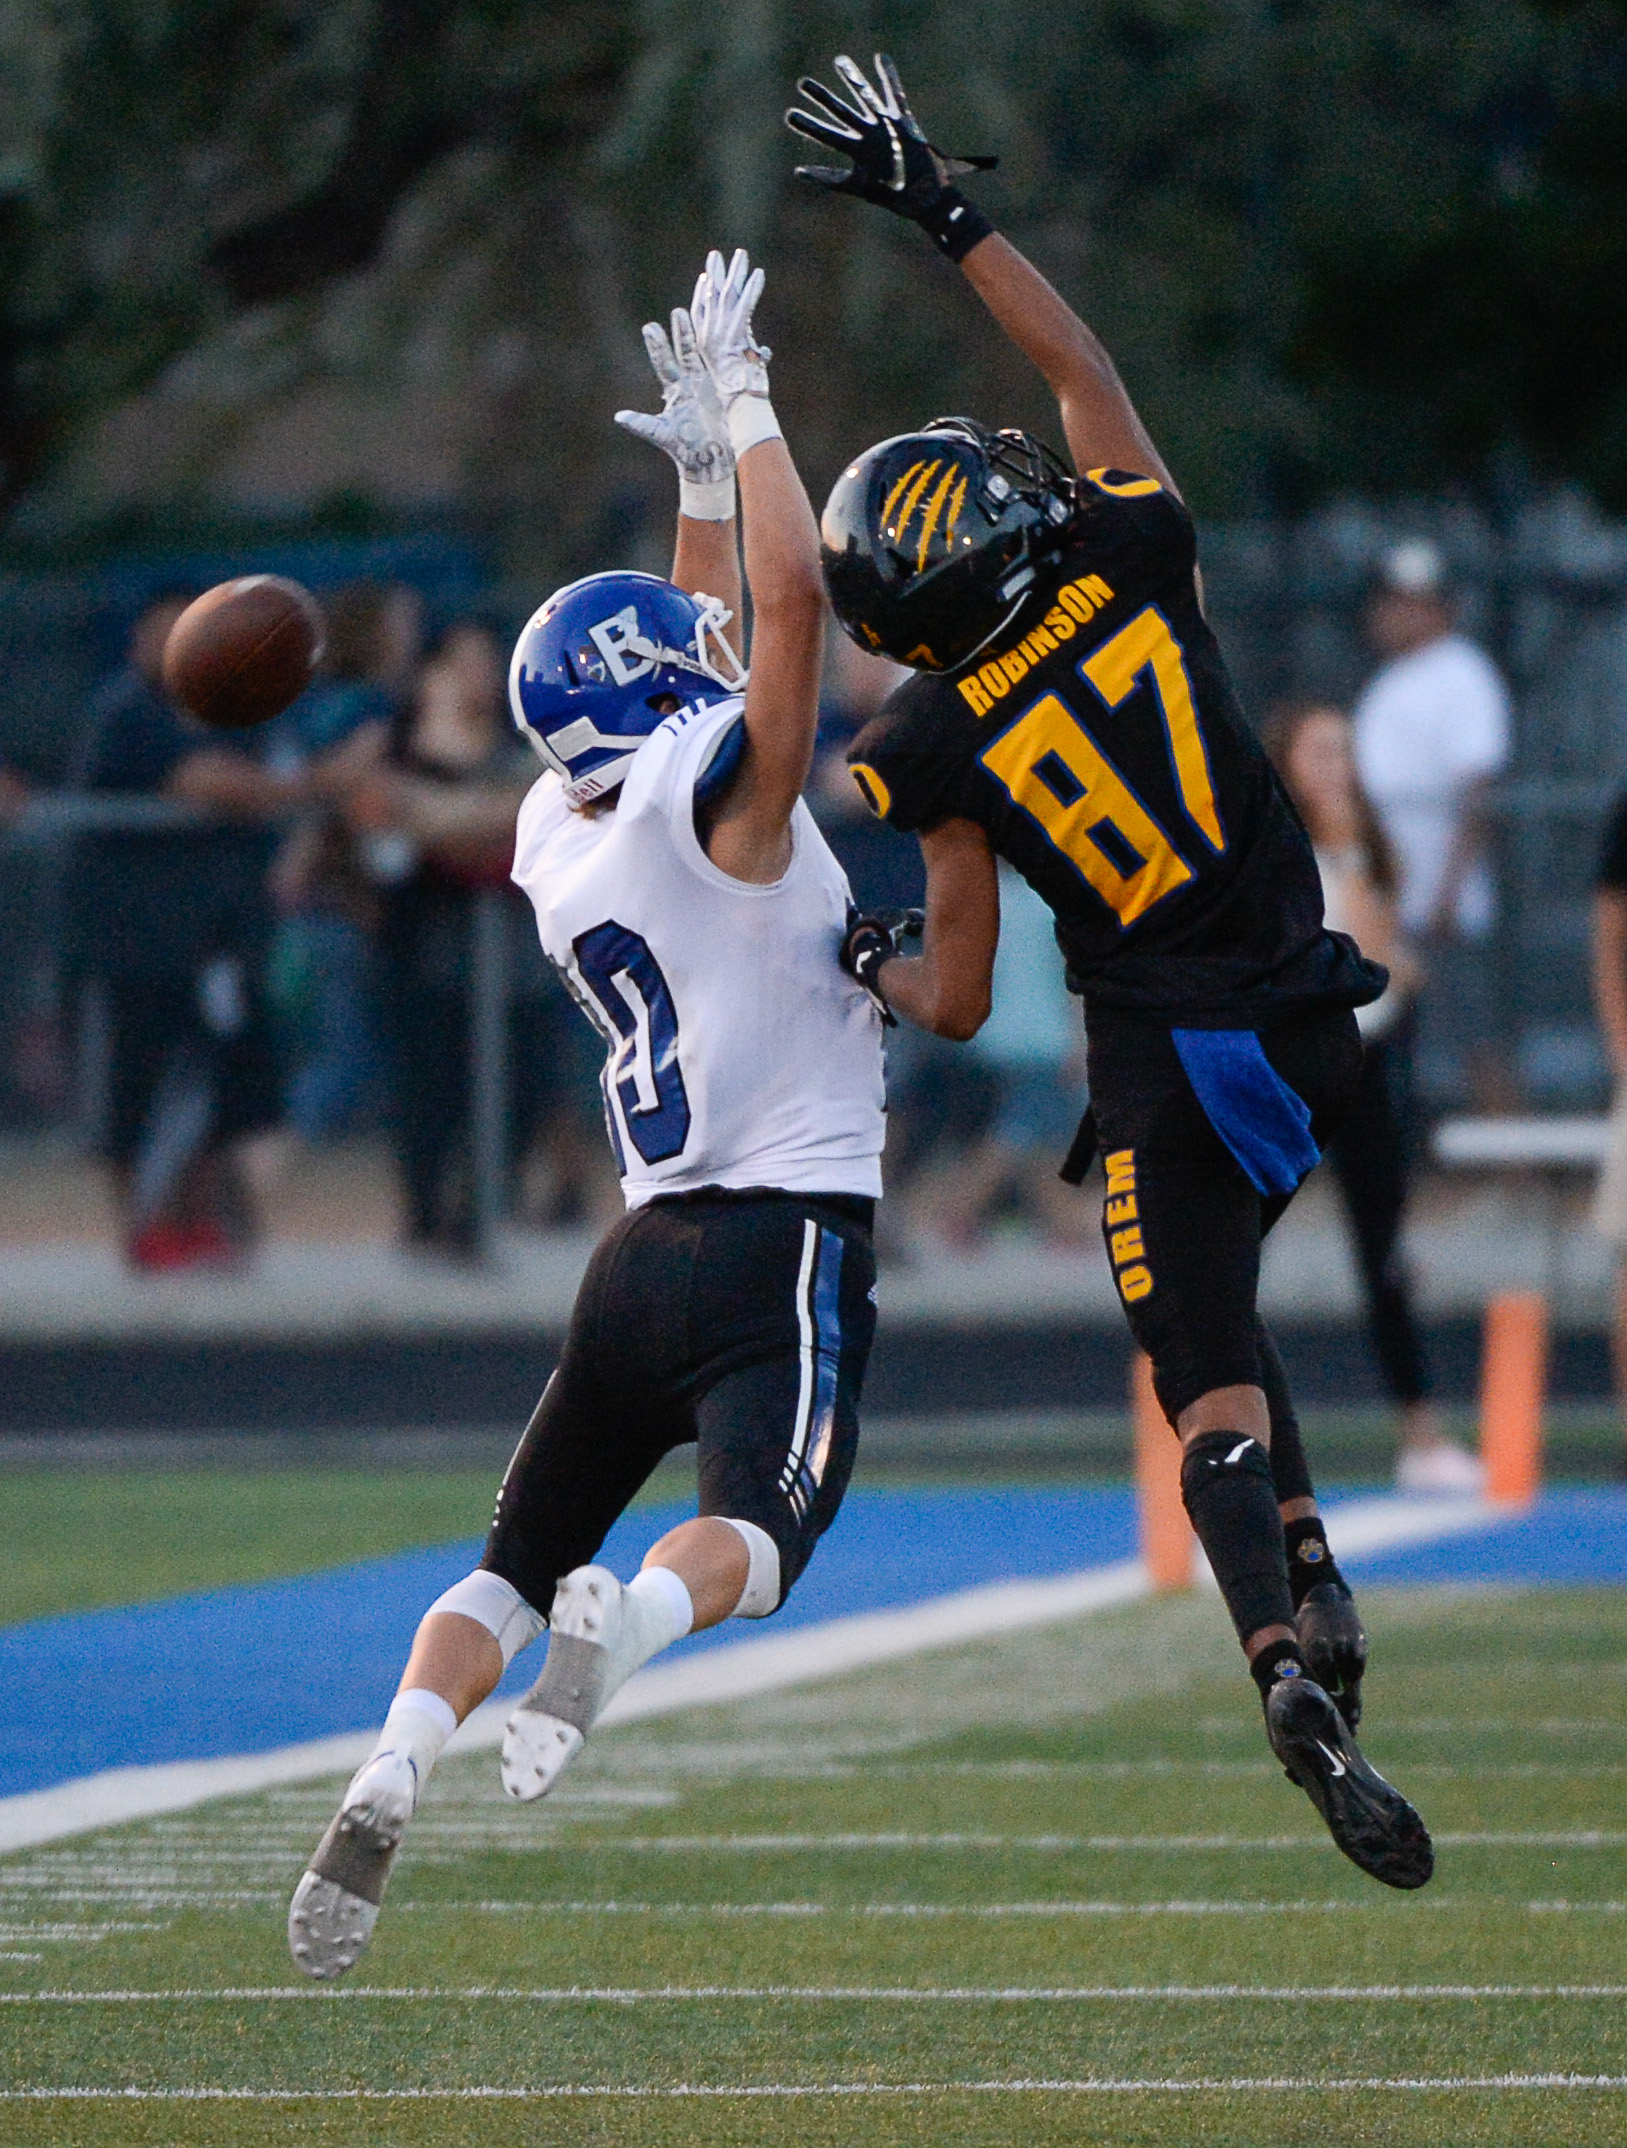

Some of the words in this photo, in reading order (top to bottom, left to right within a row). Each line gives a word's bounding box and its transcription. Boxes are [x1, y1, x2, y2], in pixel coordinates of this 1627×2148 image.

[956, 573, 1116, 718] ROBINSON
[975, 602, 1227, 932] 87
[1104, 1147, 1154, 1303] OREM
